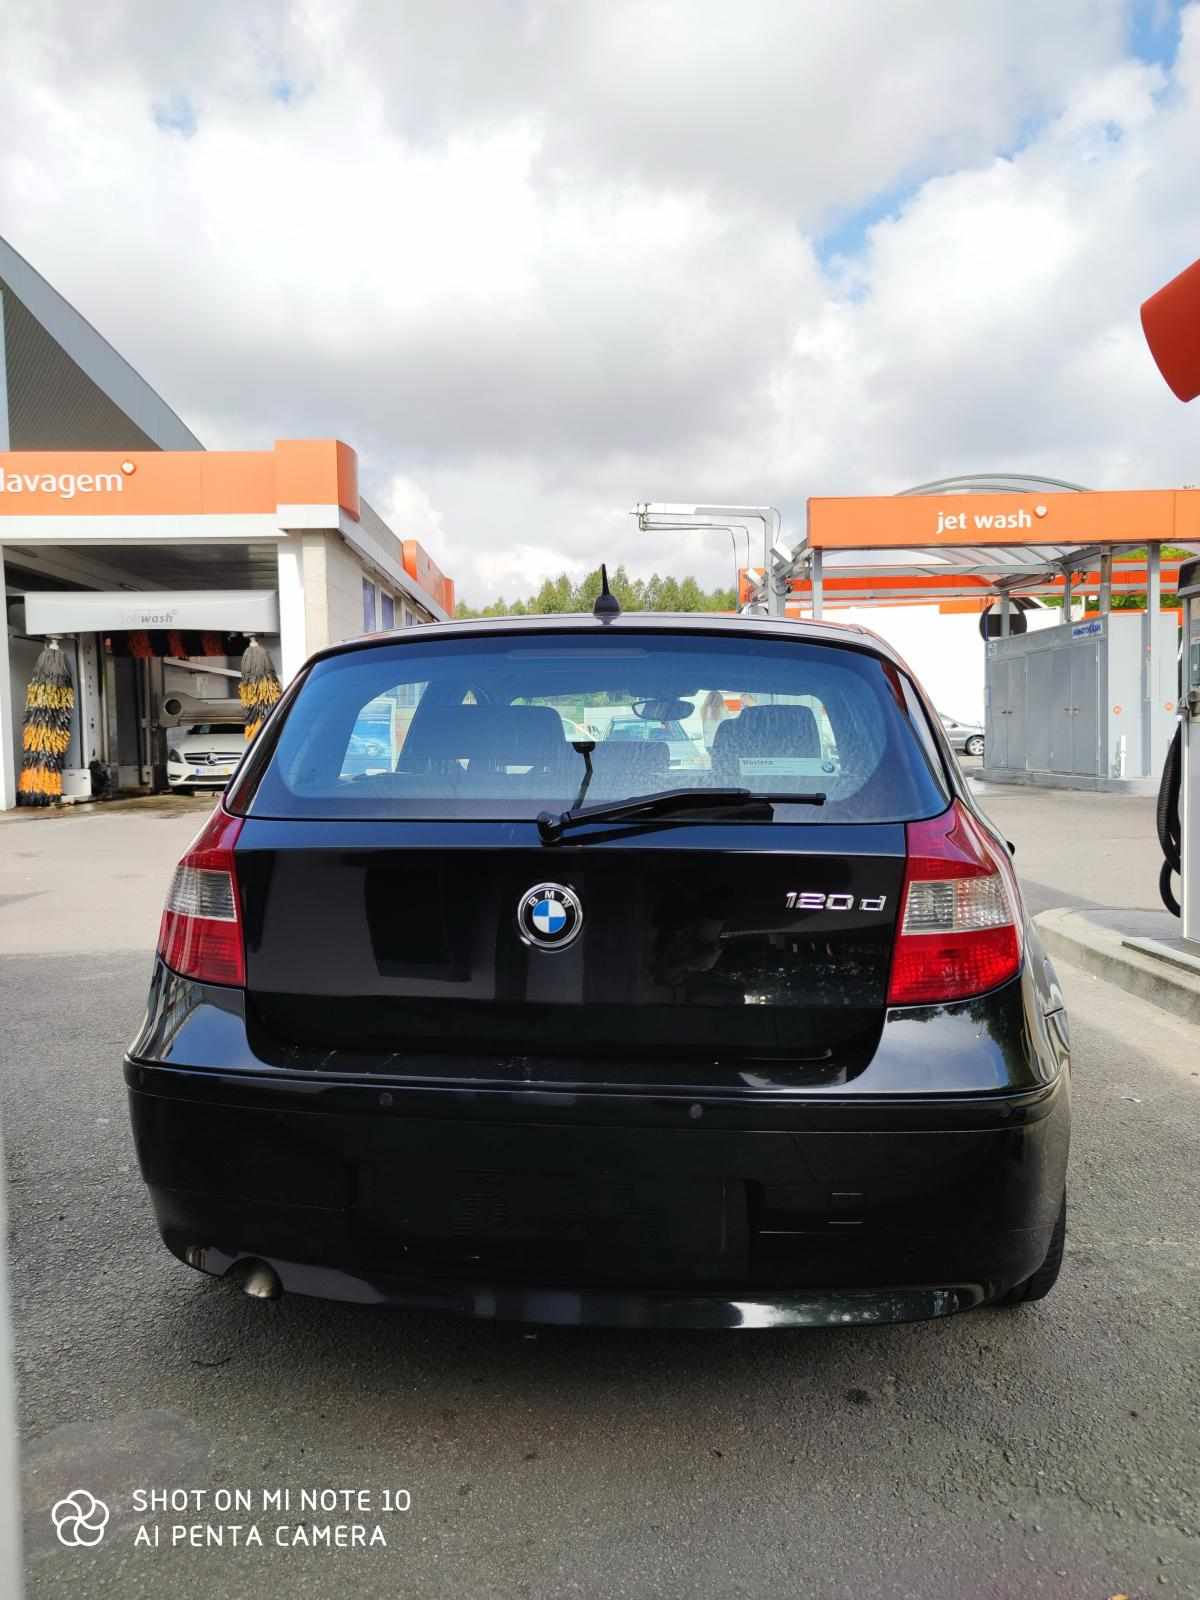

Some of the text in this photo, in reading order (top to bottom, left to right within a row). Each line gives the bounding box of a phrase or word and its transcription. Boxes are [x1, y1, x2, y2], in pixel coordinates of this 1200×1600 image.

[0, 467, 123, 499] lavagem
[936, 508, 1032, 535] jet wash
[528, 890, 572, 908] BMW
